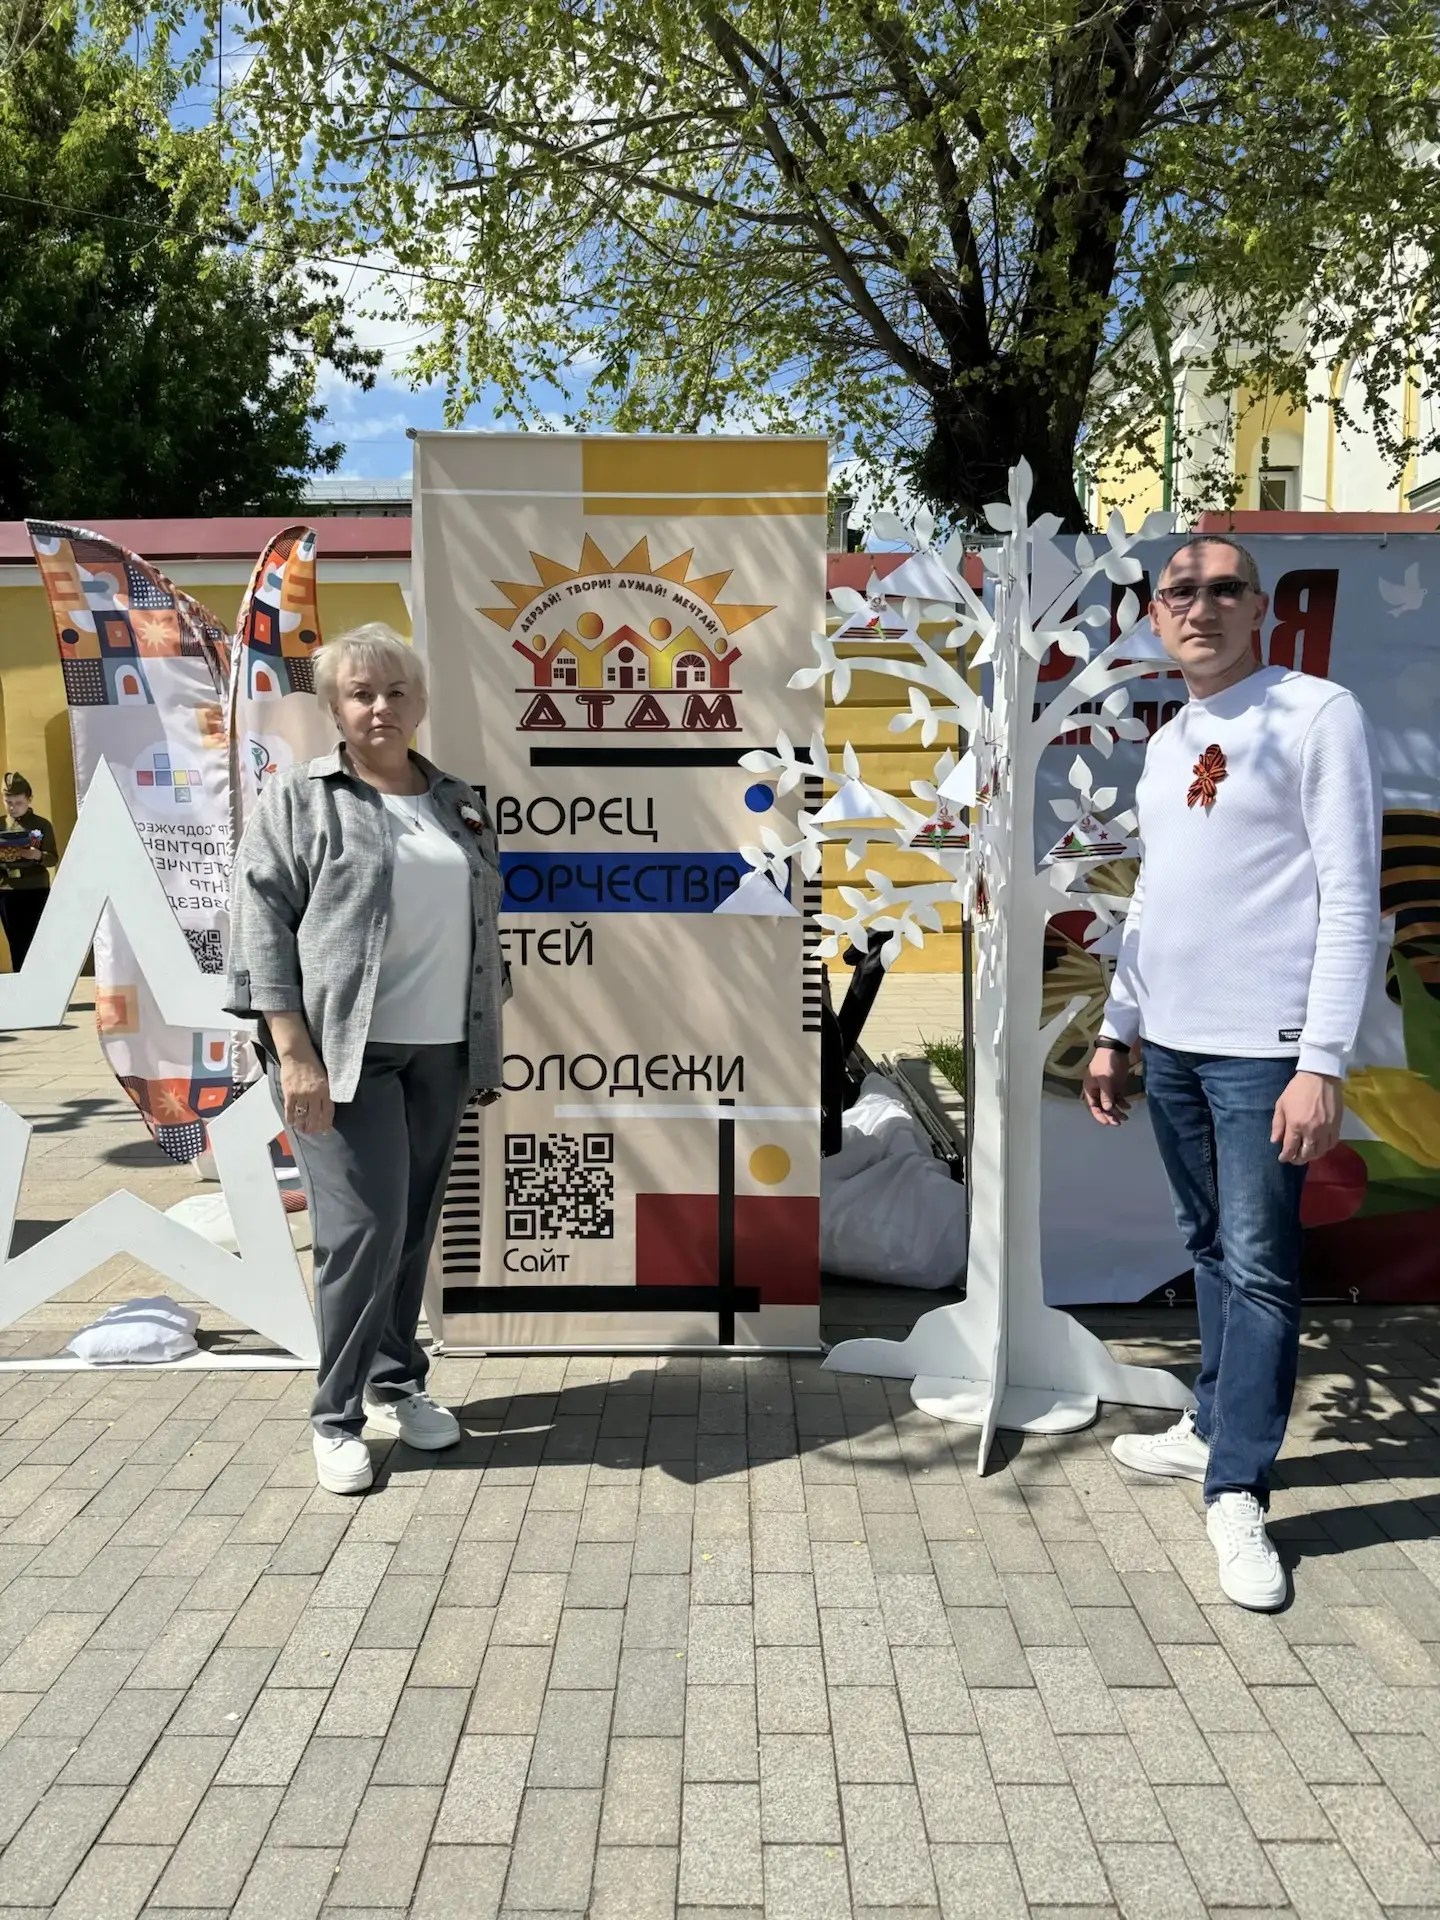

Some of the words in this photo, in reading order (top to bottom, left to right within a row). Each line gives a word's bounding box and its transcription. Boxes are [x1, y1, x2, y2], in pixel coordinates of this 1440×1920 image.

[520, 592, 562, 633] ДЕРЗАЙ!
[566, 579, 612, 596] ТВОРИ!
[618, 579, 667, 597] ДУМАЙ!
[672, 593, 718, 635] МЕЧТАЙ!
[470, 785, 658, 842] ВОРЕЦ
[504, 864, 741, 903] ОРЧЕСТВА
[501, 1054, 745, 1097] ОЛОДЕЖИ
[503, 1247, 571, 1272] Сайт
